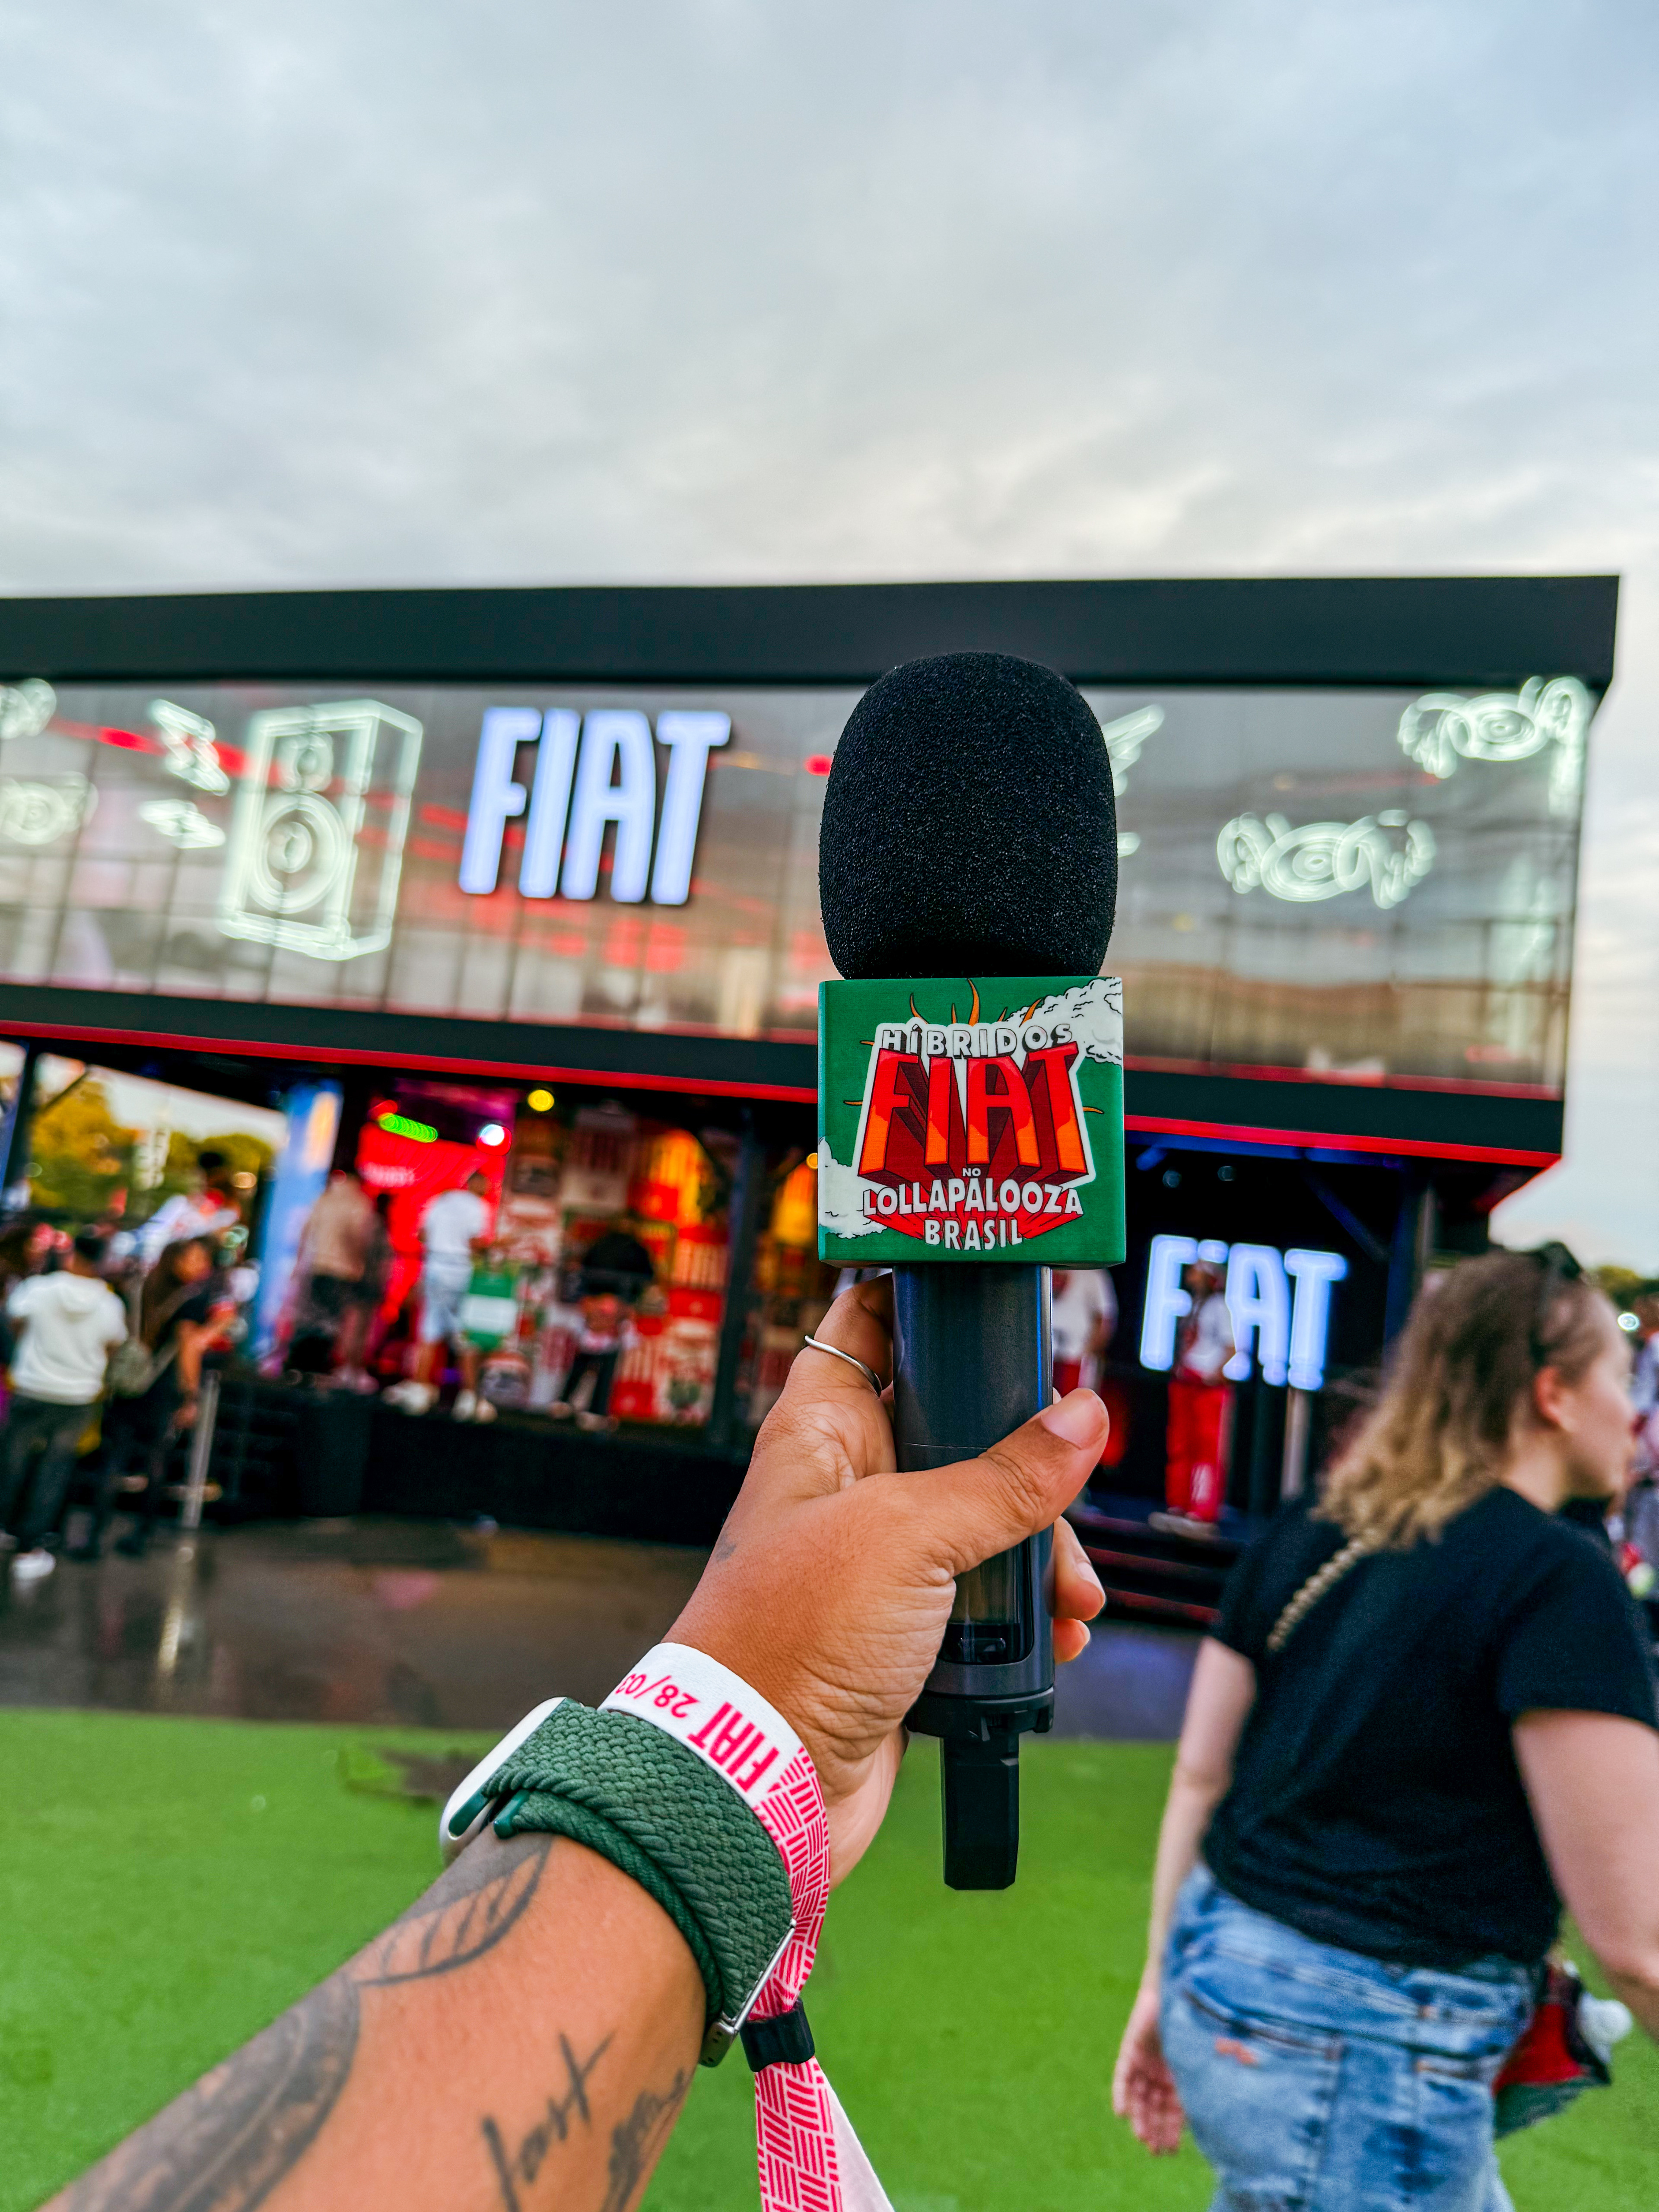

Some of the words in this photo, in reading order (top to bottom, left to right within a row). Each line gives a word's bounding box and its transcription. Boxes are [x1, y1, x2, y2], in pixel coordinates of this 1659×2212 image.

[458, 706, 732, 905] FIAT
[880, 1023, 1073, 1059] HÍBRIDOS
[857, 1041, 1089, 1177] FIAT
[863, 1177, 1084, 1216] LOLLAPALOOZA
[962, 1167, 981, 1177] NO
[924, 1217, 1023, 1251] BRASIL
[1139, 1234, 1348, 1391] FAT
[687, 1702, 779, 1793] FIAT
